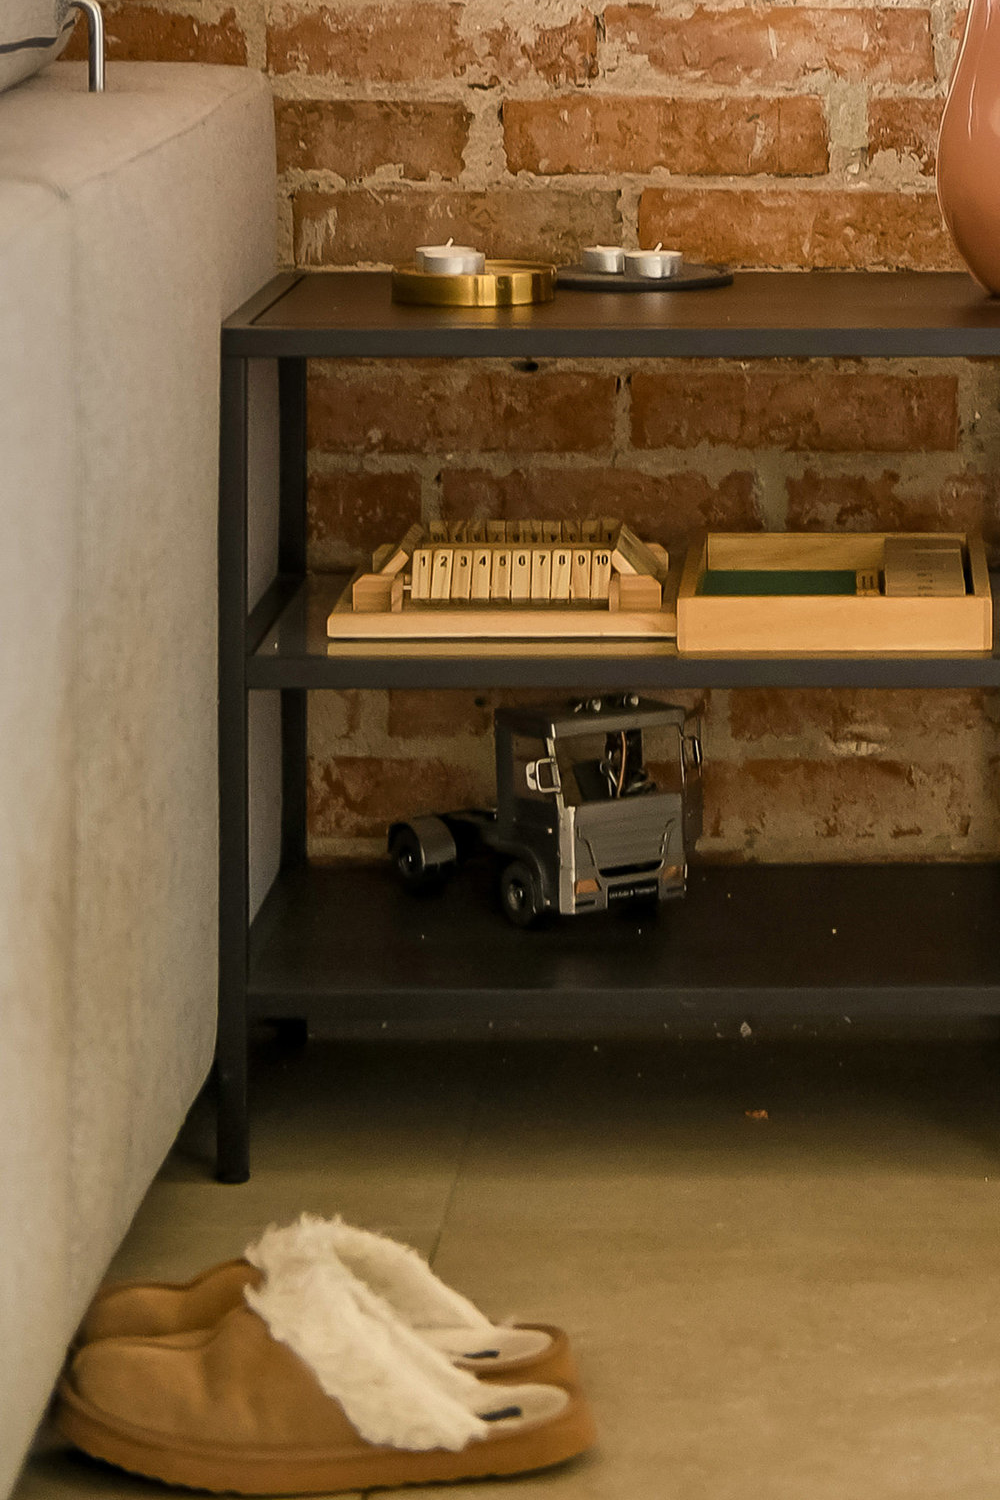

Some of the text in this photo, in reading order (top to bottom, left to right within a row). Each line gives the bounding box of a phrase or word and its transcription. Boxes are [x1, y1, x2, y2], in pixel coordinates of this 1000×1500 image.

[421, 555, 609, 567] 1 2 3 4 5 6 7 8 9 10
